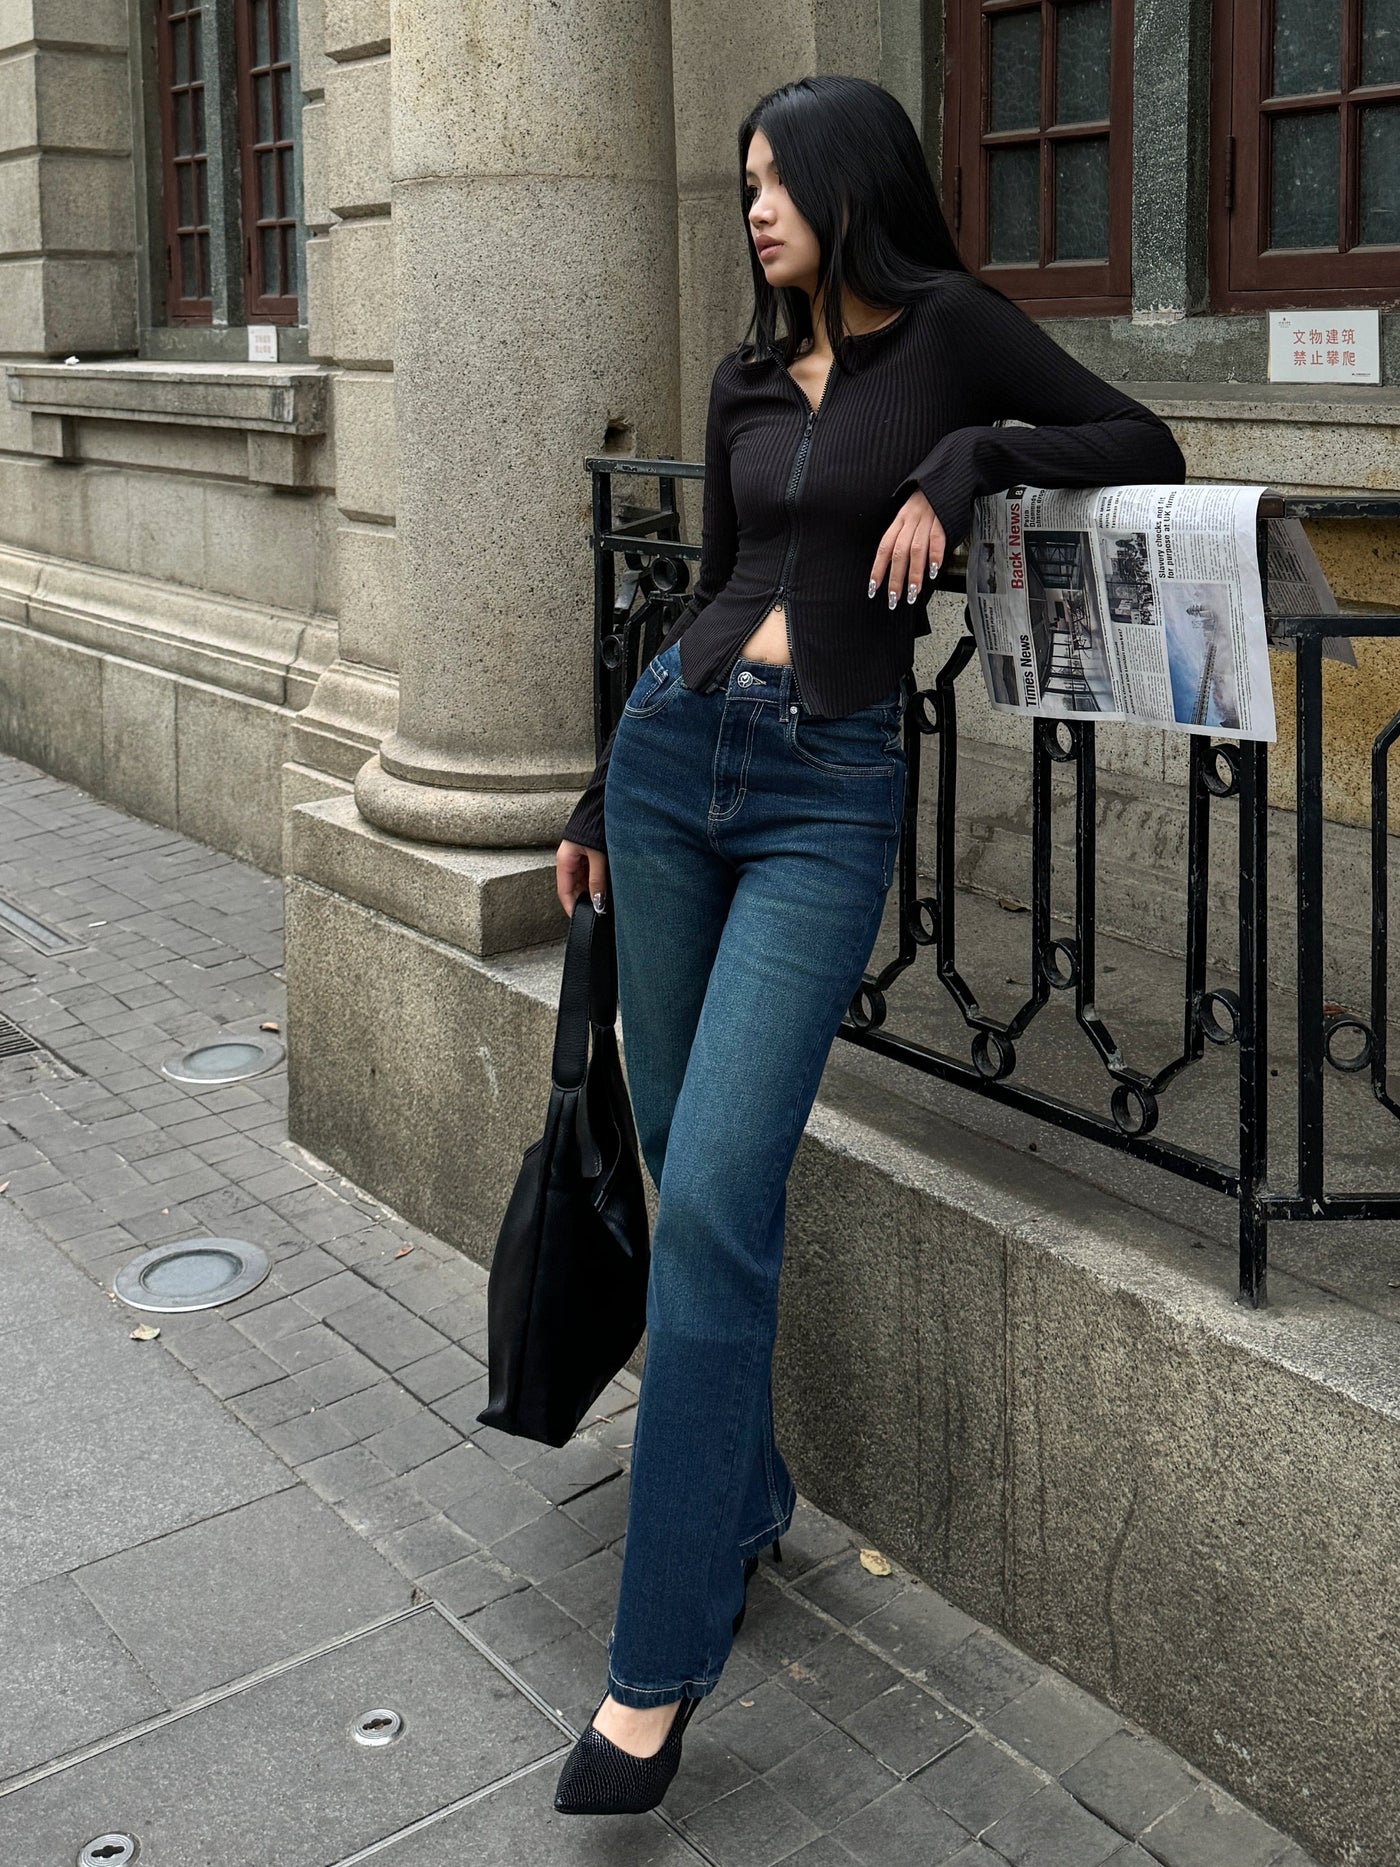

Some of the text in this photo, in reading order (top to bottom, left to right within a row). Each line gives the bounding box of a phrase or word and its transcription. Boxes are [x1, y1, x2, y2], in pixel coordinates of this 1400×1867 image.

[1293, 329, 1356, 345] 文物建筑
[1293, 350, 1356, 367] 禁止攀爬
[1158, 496, 1166, 505] fit
[1166, 490, 1177, 509] firms
[1164, 510, 1171, 522] UK
[1155, 521, 1164, 548] checks
[1164, 524, 1170, 532] at
[1008, 503, 1024, 589] Back News
[1164, 534, 1174, 566] purpose
[1020, 634, 1037, 707] Times News
